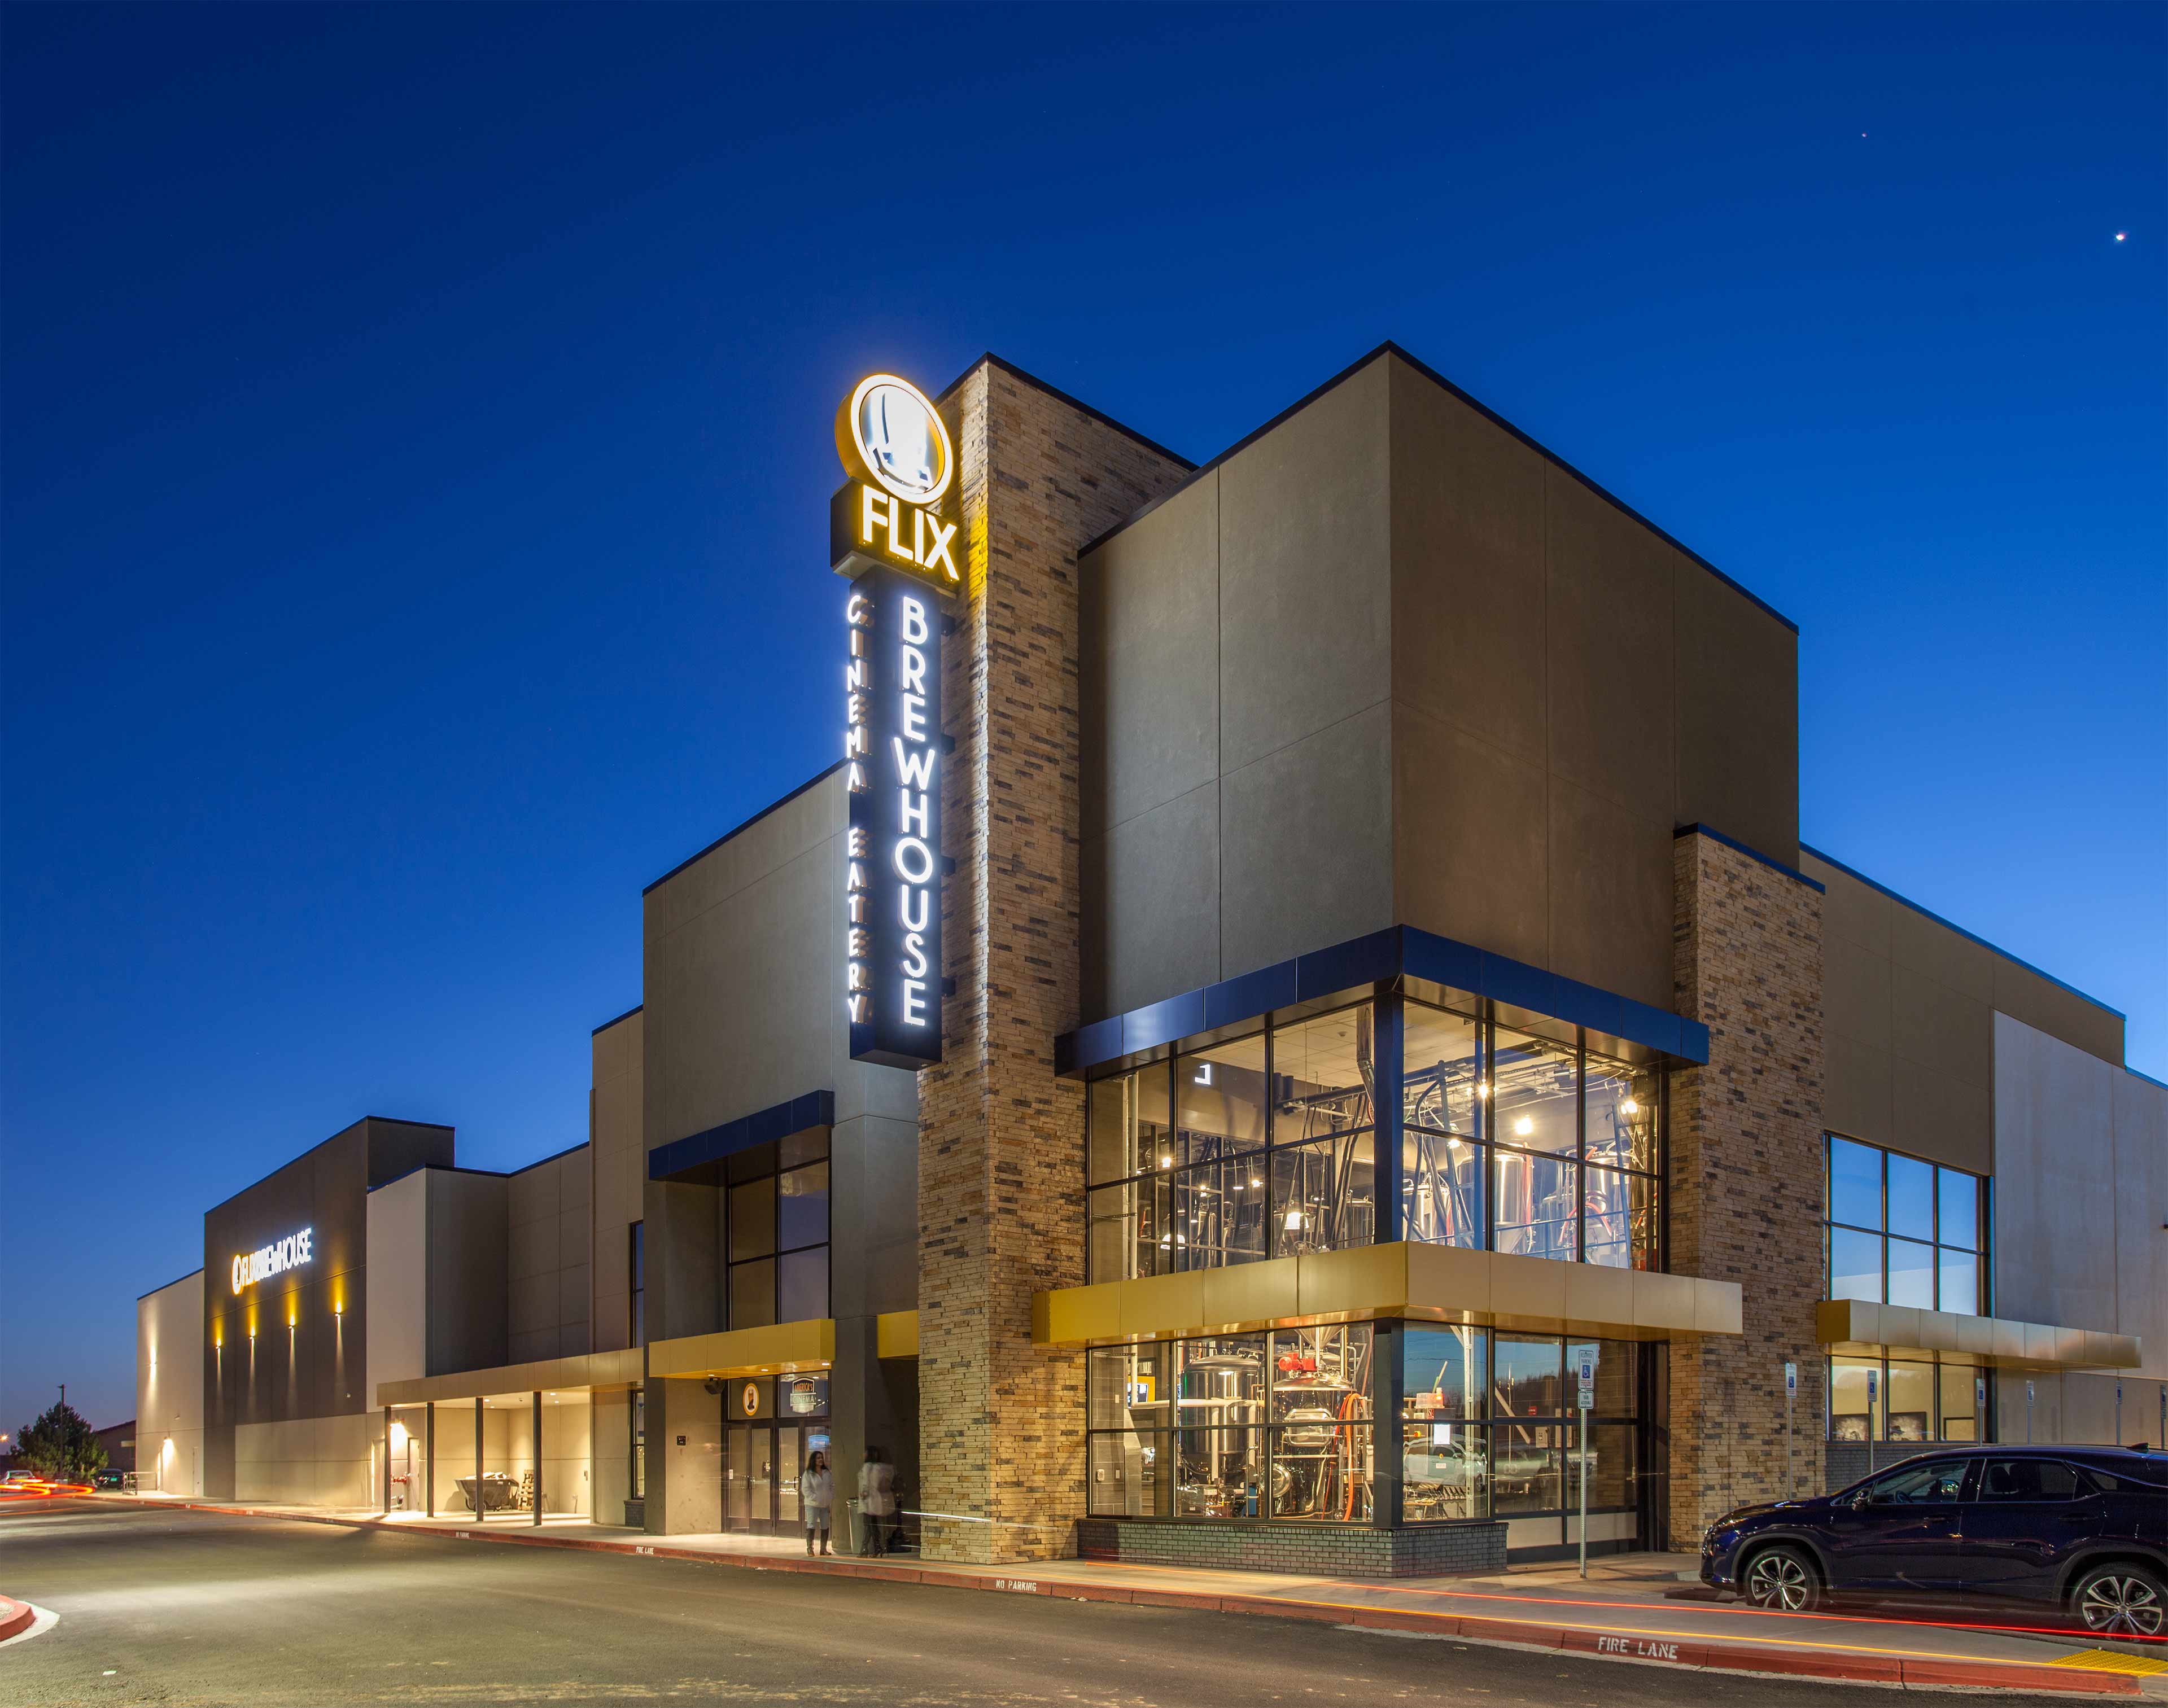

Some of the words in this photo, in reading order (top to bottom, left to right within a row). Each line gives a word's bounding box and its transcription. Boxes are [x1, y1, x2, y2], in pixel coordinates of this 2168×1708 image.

[863, 485, 959, 581] FLIX
[847, 595, 861, 791] CINEMA
[894, 596, 935, 1026] BREWHOUSE
[847, 827, 859, 1022] EATERY
[256, 1228, 312, 1280] EWHOUSE
[996, 1579, 1004, 1589] NO
[1008, 1580, 1037, 1592] PARKING
[1598, 1636, 1630, 1653] FIRE
[1637, 1641, 1679, 1659] LANE
